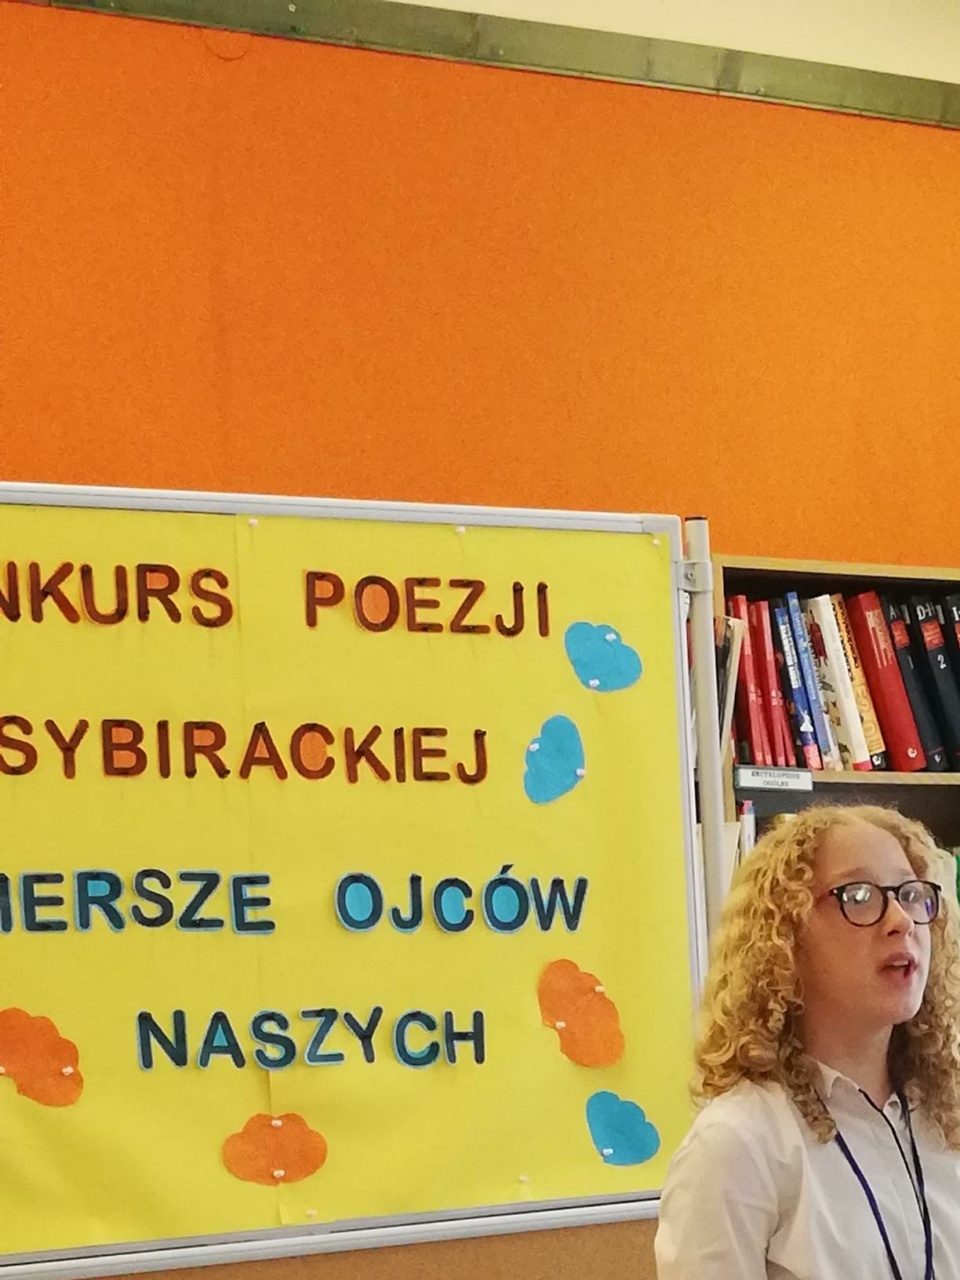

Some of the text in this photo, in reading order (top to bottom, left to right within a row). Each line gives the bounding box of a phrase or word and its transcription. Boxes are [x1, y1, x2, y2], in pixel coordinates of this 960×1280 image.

[304, 571, 551, 638] POEZJI
[937, 654, 947, 669] 2
[0, 715, 489, 785] SYBIRACKIEJ
[0, 863, 589, 935] IERSZE OJCÓW
[136, 1005, 486, 1072] NASZYCH
